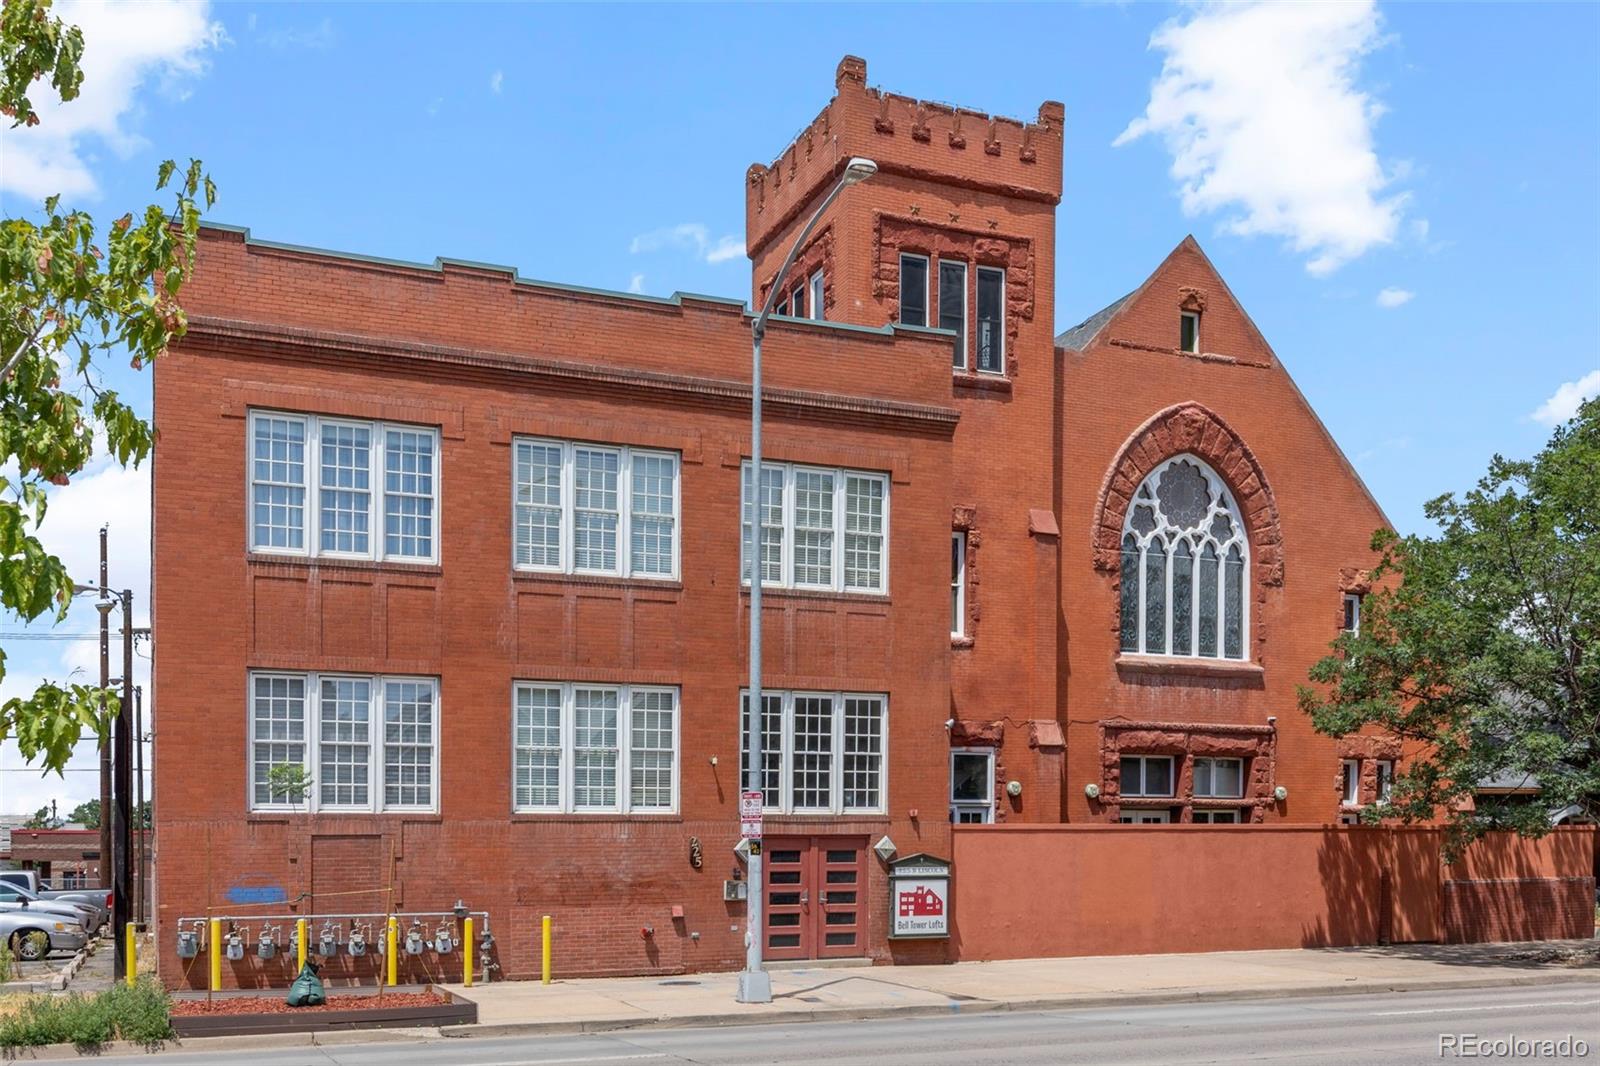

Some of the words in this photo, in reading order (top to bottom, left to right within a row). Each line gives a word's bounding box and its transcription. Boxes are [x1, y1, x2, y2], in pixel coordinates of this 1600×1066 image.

[690, 836, 702, 868] 225
[898, 920, 909, 930] Bell
[910, 920, 927, 929] Tower
[928, 919, 944, 930] Lofts
